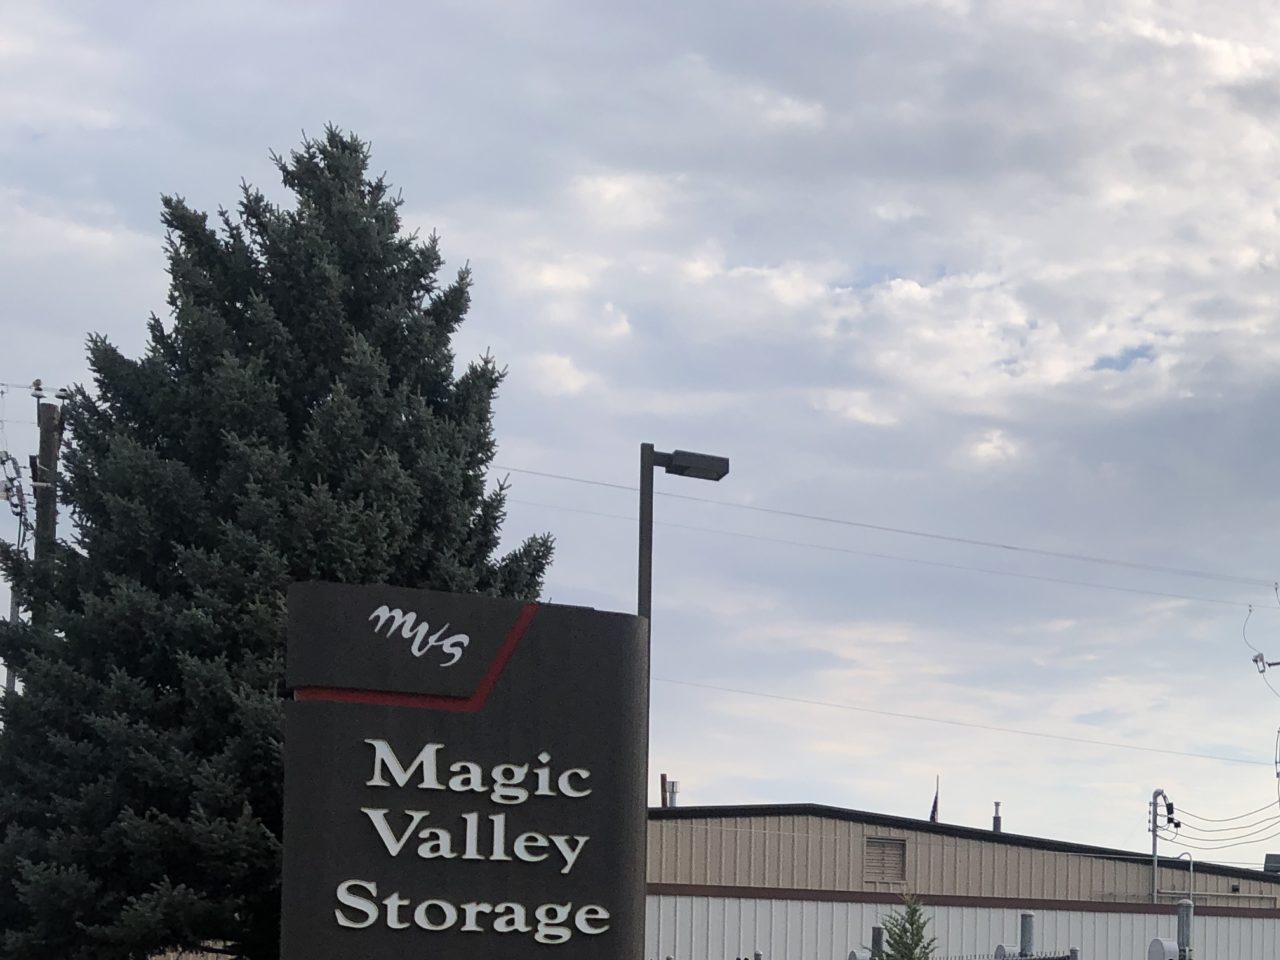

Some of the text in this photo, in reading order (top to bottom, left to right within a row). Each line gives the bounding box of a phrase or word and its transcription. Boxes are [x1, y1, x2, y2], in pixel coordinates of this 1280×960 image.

[364, 738, 593, 805] Magic
[361, 807, 590, 875] Valley
[334, 879, 611, 944] Storage
